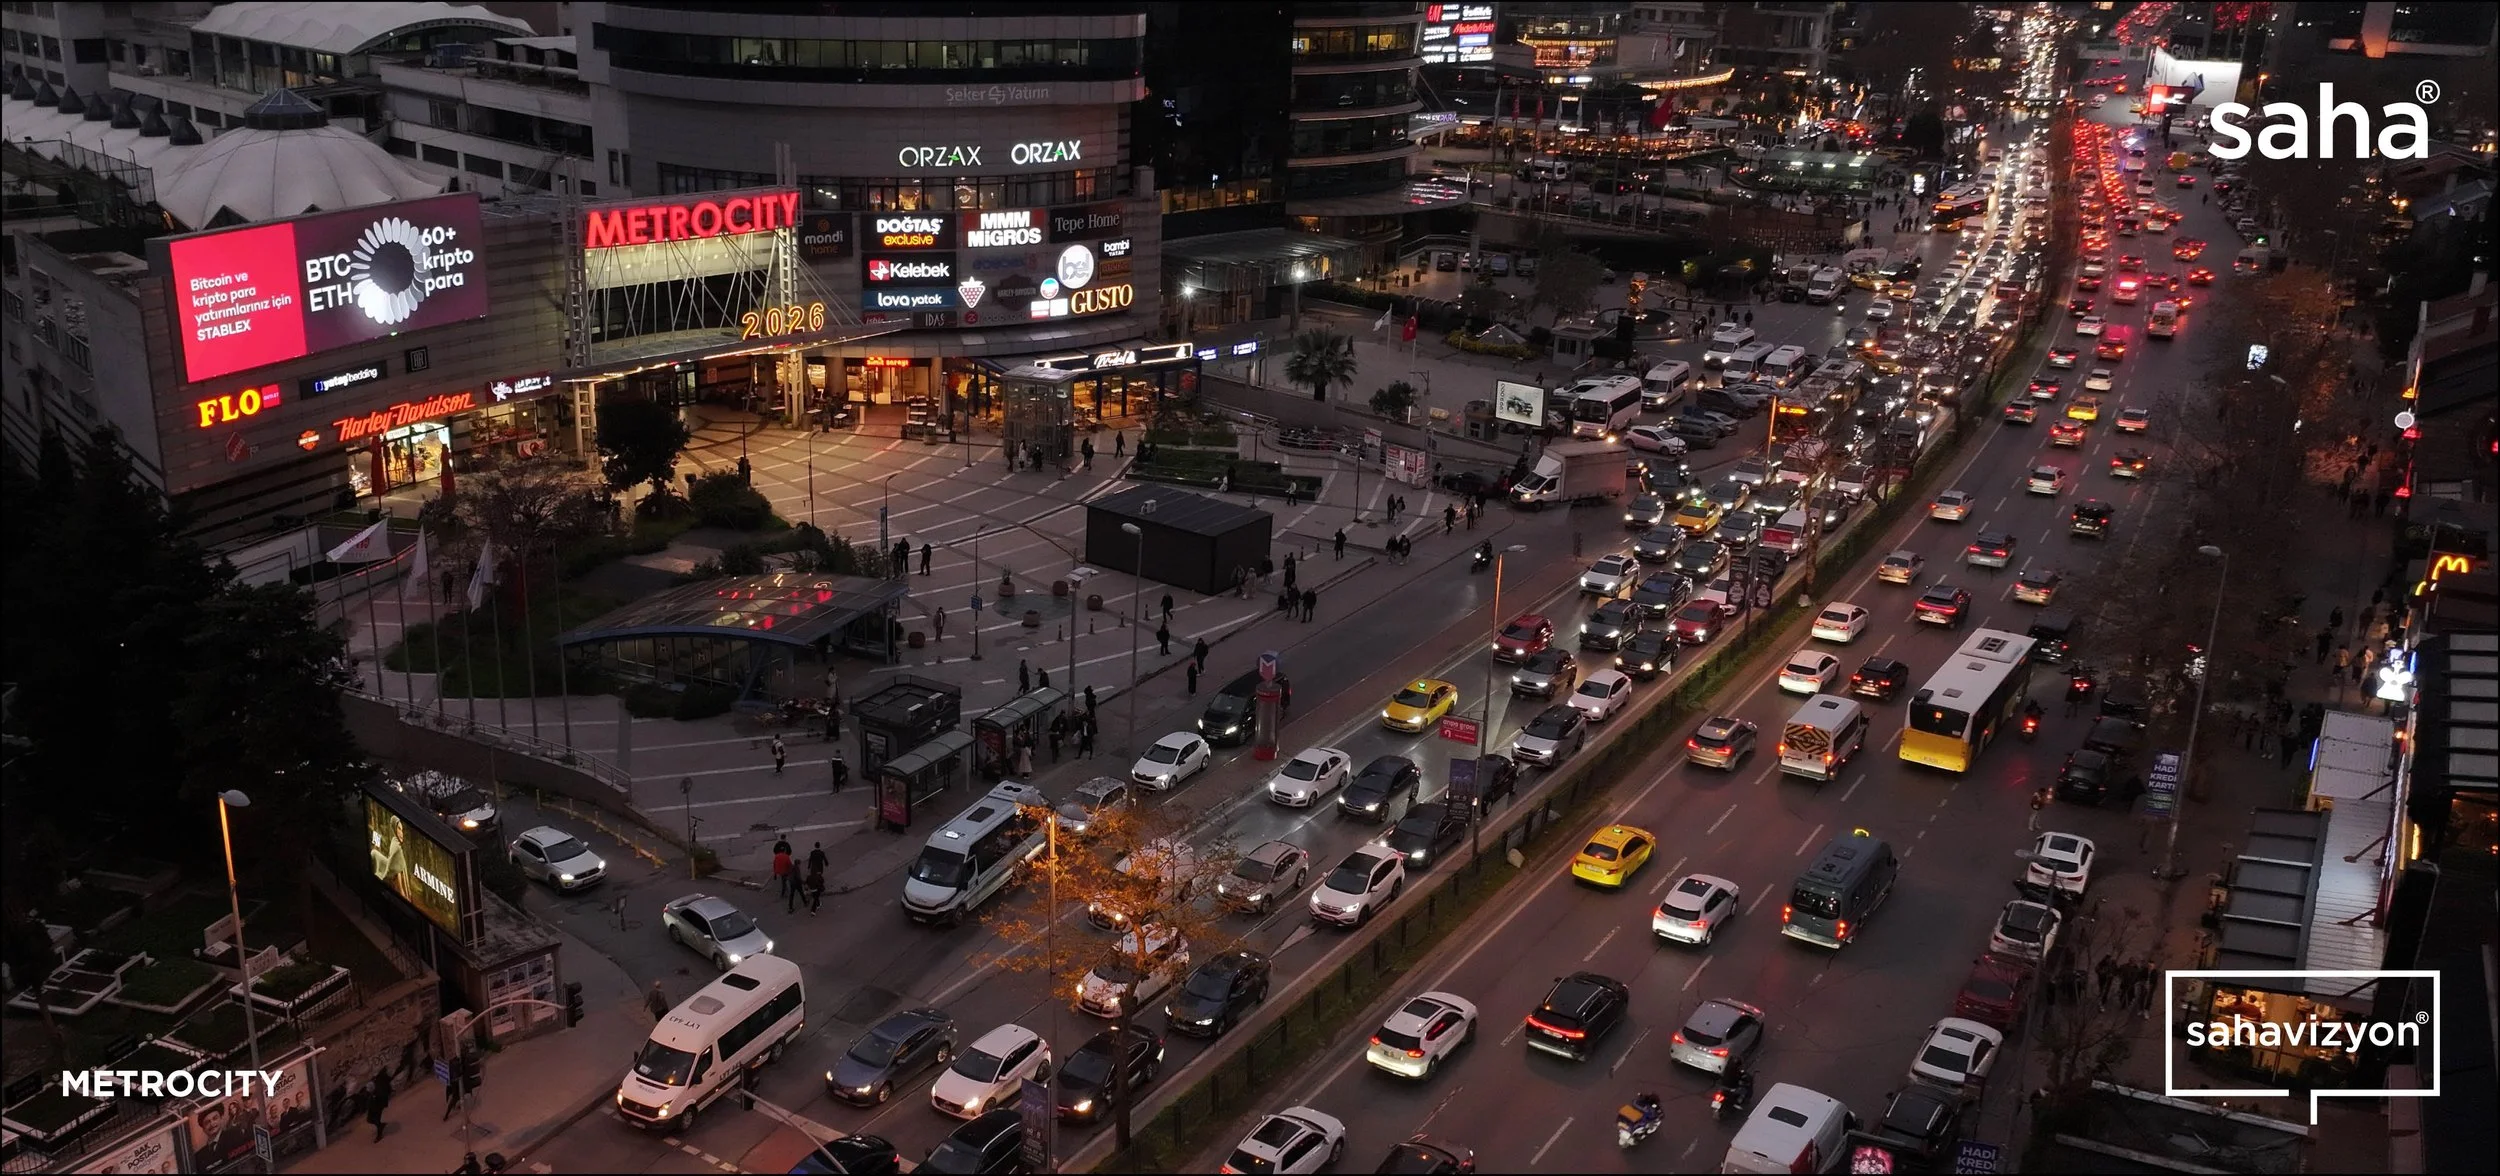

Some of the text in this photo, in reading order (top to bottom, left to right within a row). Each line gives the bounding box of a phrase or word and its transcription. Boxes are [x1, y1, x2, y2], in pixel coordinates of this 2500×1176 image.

[898, 146, 982, 168] ORZAX
[1011, 140, 1081, 166] ORZAX
[587, 192, 800, 247] METROCITY
[876, 216, 942, 235] DOĞTAŞ
[980, 211, 1030, 230] MMM
[1055, 214, 1120, 234] Tepe Home
[421, 226, 456, 247] 60+
[804, 230, 844, 246] mondi
[884, 234, 934, 246] exclusive
[1104, 239, 1130, 252] bambi
[422, 241, 474, 271] kripto
[810, 244, 838, 254] home
[306, 253, 351, 283] BTC
[890, 262, 950, 278] Kelebek
[190, 271, 248, 292] Bitcoin ve
[424, 272, 463, 297] para
[192, 286, 256, 310] kripto para
[271, 294, 292, 312] için
[310, 281, 353, 312] ETH
[878, 292, 942, 307] lova yatak
[1070, 284, 1133, 314] GUSTO
[196, 319, 251, 342] STABLEX
[742, 302, 825, 340] 2026
[198, 389, 261, 427] FLO
[333, 392, 476, 442] Harley-Davidson
[413, 862, 455, 904] ARMINE
[127, 1143, 162, 1170] POSTACI
[134, 1142, 151, 1157] BAK
